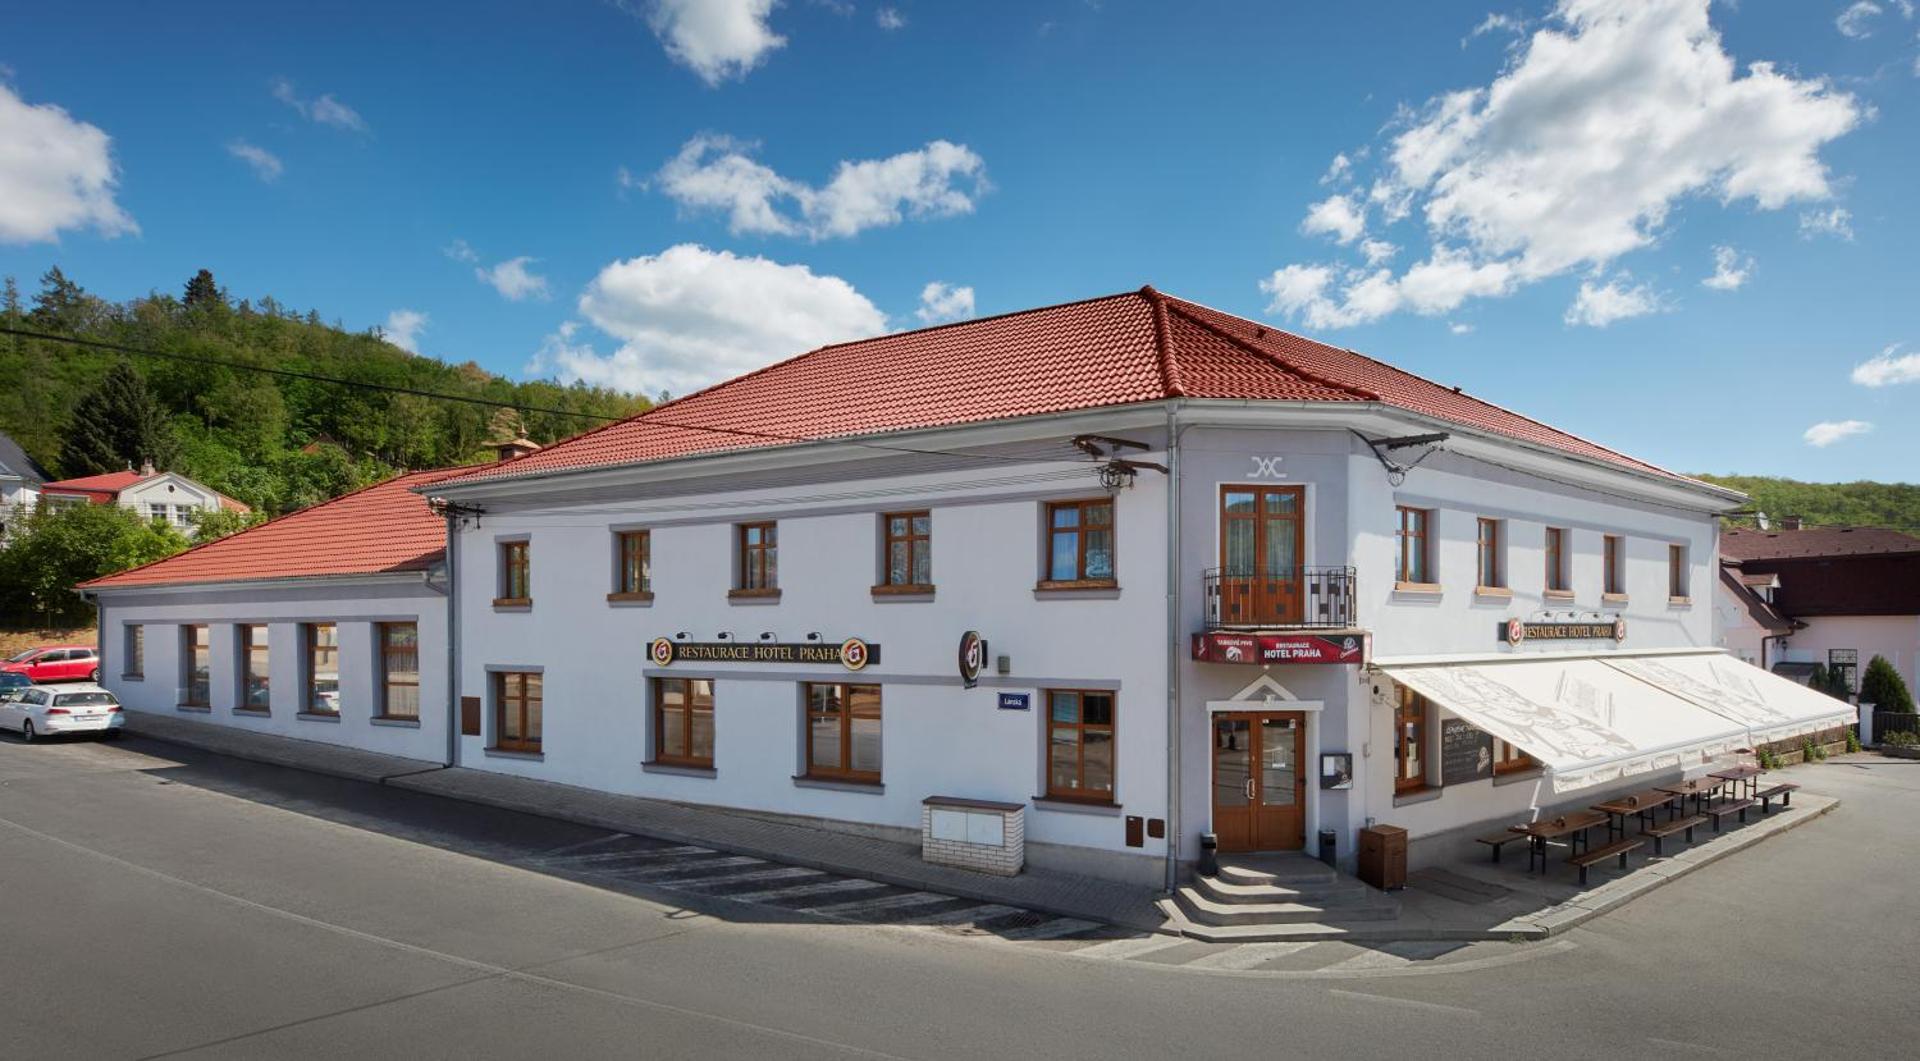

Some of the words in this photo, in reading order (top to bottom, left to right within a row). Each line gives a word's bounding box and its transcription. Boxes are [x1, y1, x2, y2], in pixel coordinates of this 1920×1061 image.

[1569, 625, 1590, 637] HOTEL
[679, 646, 750, 659] RESTAURACE
[754, 647, 794, 660] HOTEL
[800, 647, 841, 660] PRAHA
[1264, 649, 1291, 658] HOTEL
[1292, 649, 1322, 658] PRAHA
